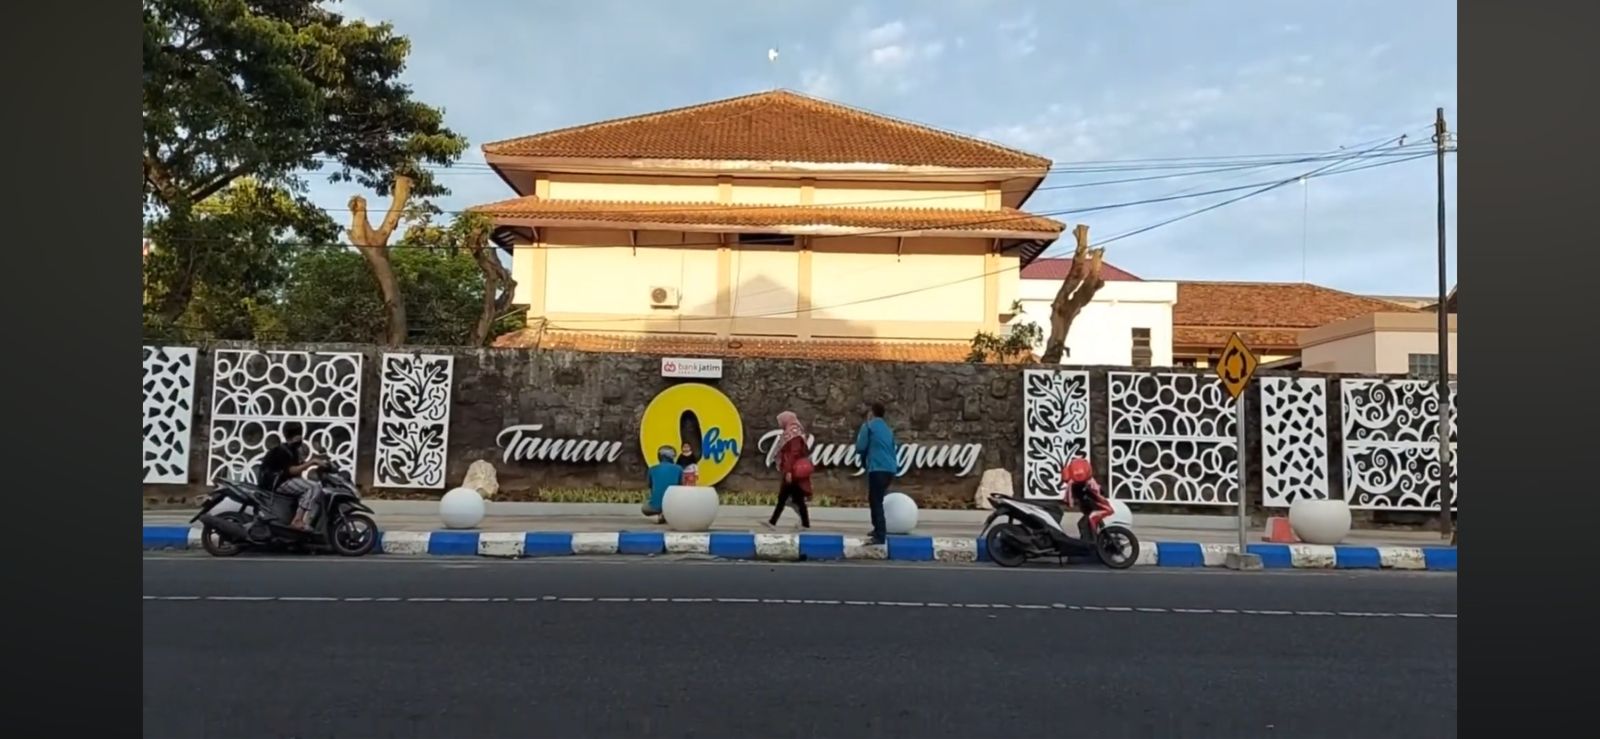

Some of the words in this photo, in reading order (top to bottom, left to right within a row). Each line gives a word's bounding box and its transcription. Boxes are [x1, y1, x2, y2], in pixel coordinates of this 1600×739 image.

[678, 362, 697, 371] bank
[698, 363, 721, 373] jatim
[495, 423, 624, 464] Taman
